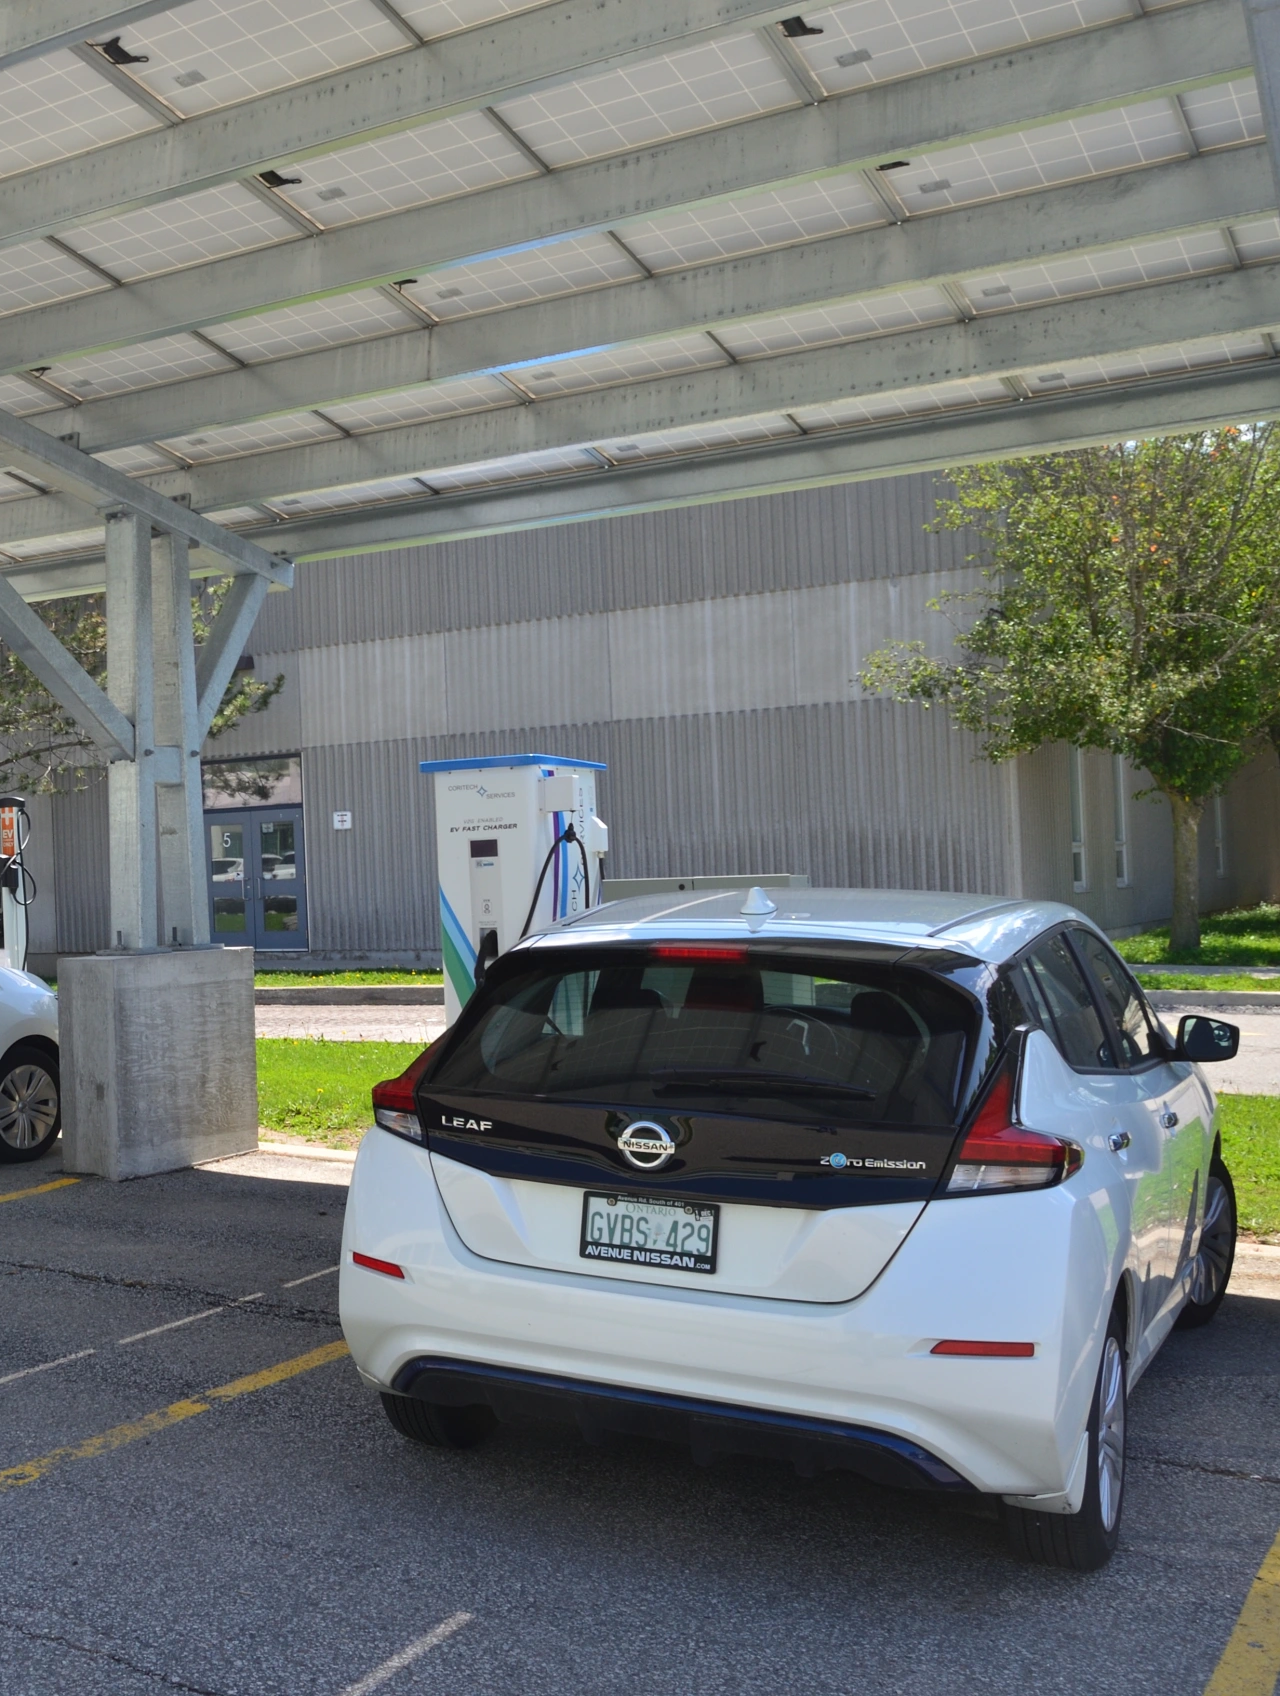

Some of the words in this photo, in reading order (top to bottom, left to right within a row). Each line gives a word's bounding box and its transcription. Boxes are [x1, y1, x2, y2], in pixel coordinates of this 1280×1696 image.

[448, 784, 478, 792] CORITECH
[486, 791, 516, 799] SERVICES
[477, 816, 504, 824] ENABLED
[483, 823, 518, 831] CHARGER
[2, 829, 14, 839] EV
[222, 832, 231, 848] 5
[441, 1115, 493, 1132] LEAF
[622, 1140, 669, 1152] NISSAN
[865, 1158, 926, 1170] Emission
[617, 1195, 638, 1203] Avenue
[648, 1197, 666, 1205] South
[590, 1211, 650, 1249] GVBS
[665, 1220, 711, 1256] 429
[585, 1245, 632, 1260] AVENUE
